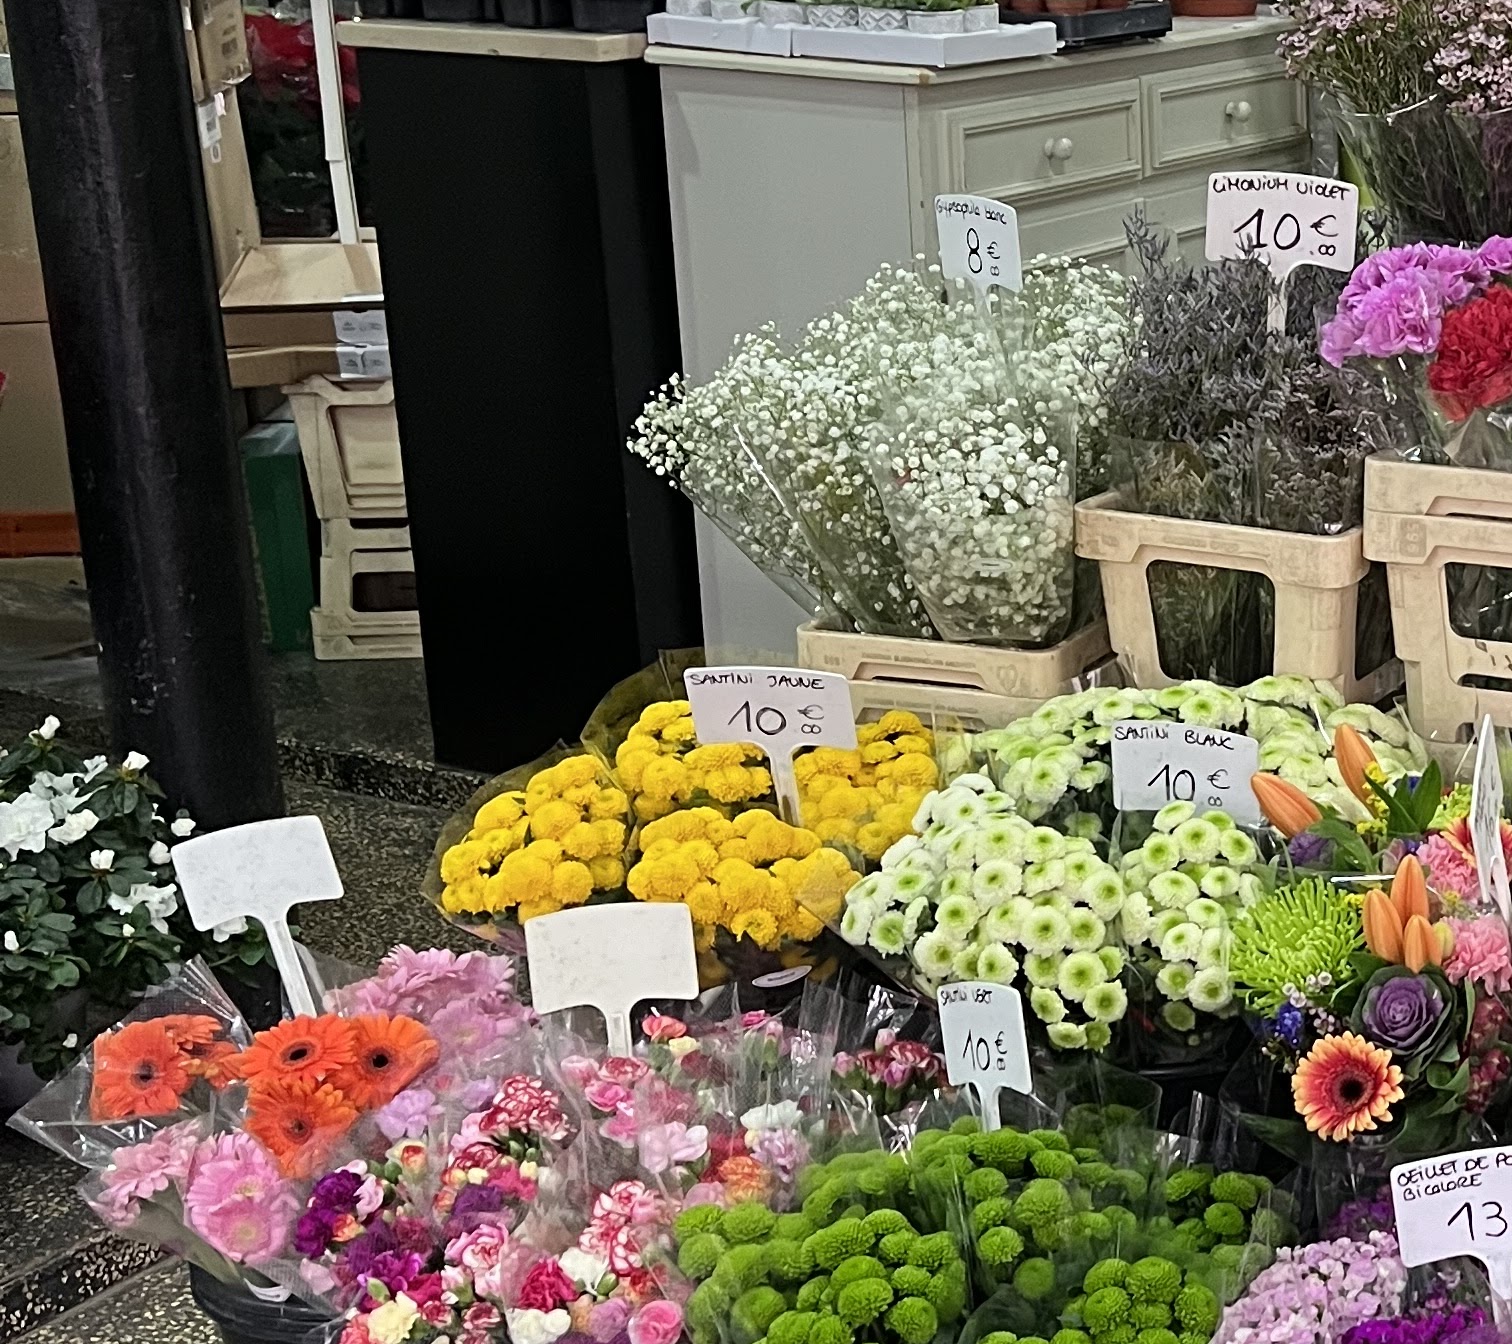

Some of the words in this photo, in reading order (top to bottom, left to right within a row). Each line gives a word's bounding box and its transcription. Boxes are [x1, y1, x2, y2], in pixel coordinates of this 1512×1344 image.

[1233, 208, 1301, 250] 10
[1310, 215, 1338, 237] €
[967, 228, 983, 273] 8
[987, 241, 1000, 259] €
[767, 675, 825, 689] JAUNE
[728, 700, 786, 735] 10
[797, 704, 824, 720] €
[1184, 730, 1234, 750] BLANC
[1148, 764, 1195, 801] 10
[1207, 769, 1230, 789] €
[963, 1029, 990, 1071] 10
[995, 1031, 1007, 1054] €
[1465, 1156, 1489, 1171] DE
[1448, 1201, 1508, 1241] 13
